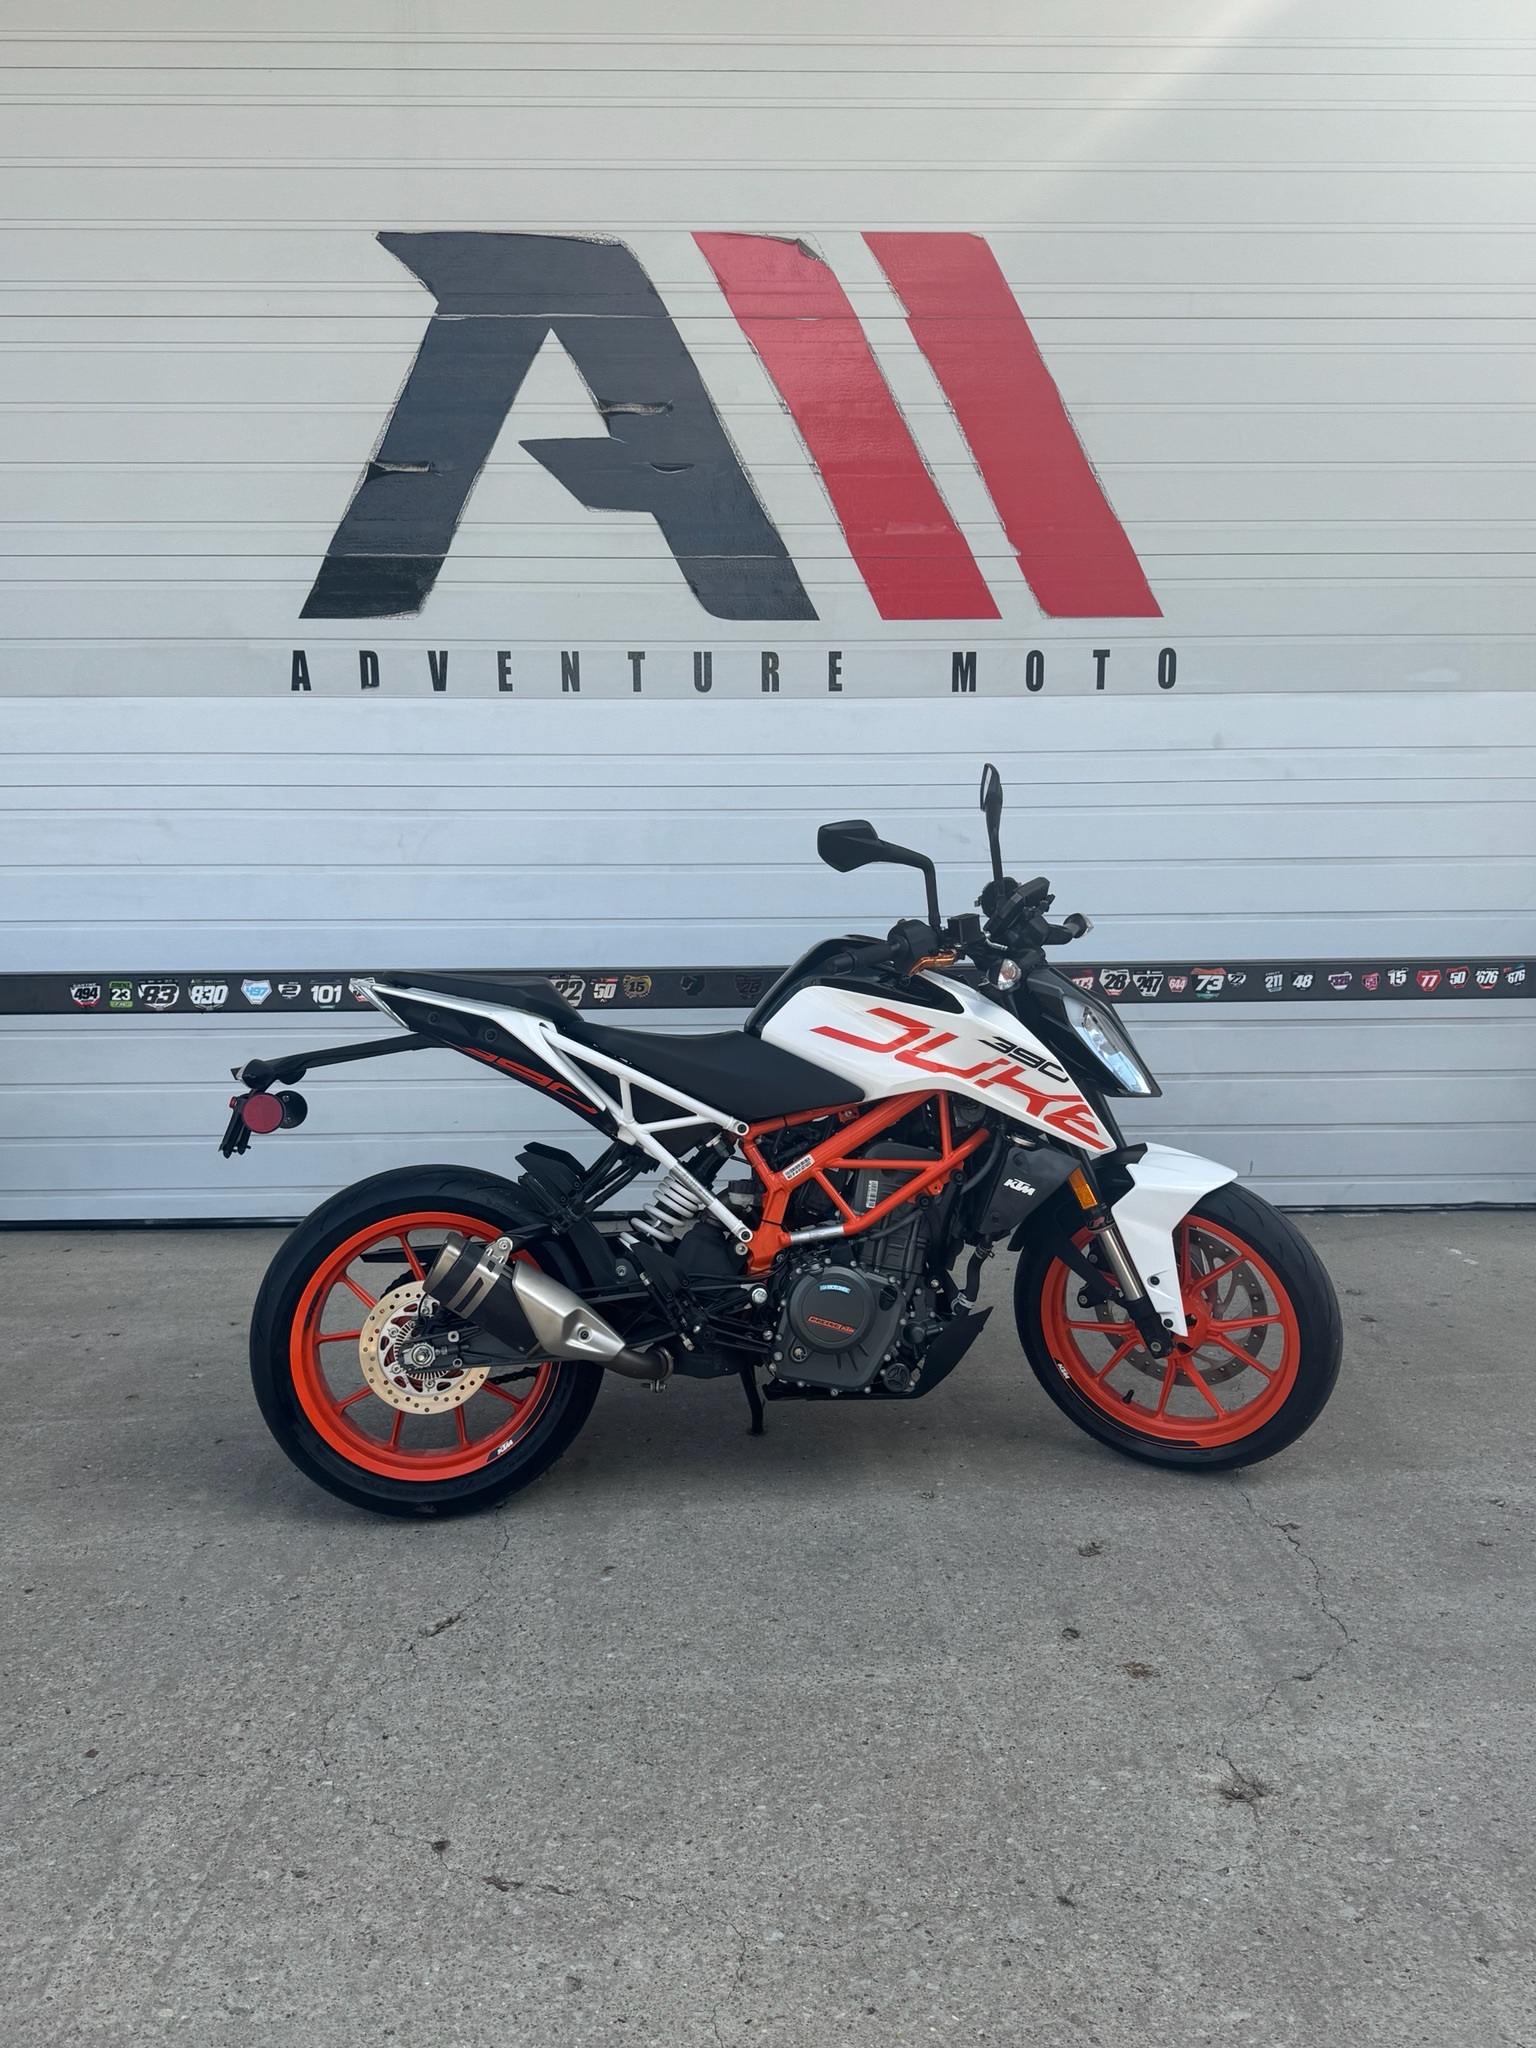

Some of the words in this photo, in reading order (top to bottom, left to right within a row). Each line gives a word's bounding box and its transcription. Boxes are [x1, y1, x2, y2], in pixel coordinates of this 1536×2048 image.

[291, 650, 843, 692] ADVENTURE
[951, 647, 1177, 692] MOTO
[1104, 973, 1127, 990] 28
[1137, 975, 1162, 992] 247
[1195, 975, 1225, 991] 73
[1265, 974, 1283, 988] 211
[1292, 974, 1313, 988] 48
[1388, 970, 1407, 985] 15
[1421, 975, 1438, 987] 77
[1449, 971, 1466, 985] 50
[74, 987, 98, 999] 494
[191, 985, 228, 1004] 830
[311, 985, 342, 1003] 101
[594, 983, 617, 999] 50
[629, 981, 645, 992] 15
[111, 989, 131, 1001] 23
[810, 1007, 1109, 1149] DUKE
[1003, 1178, 1036, 1196] KTM
[497, 1439, 514, 1455] KTM
